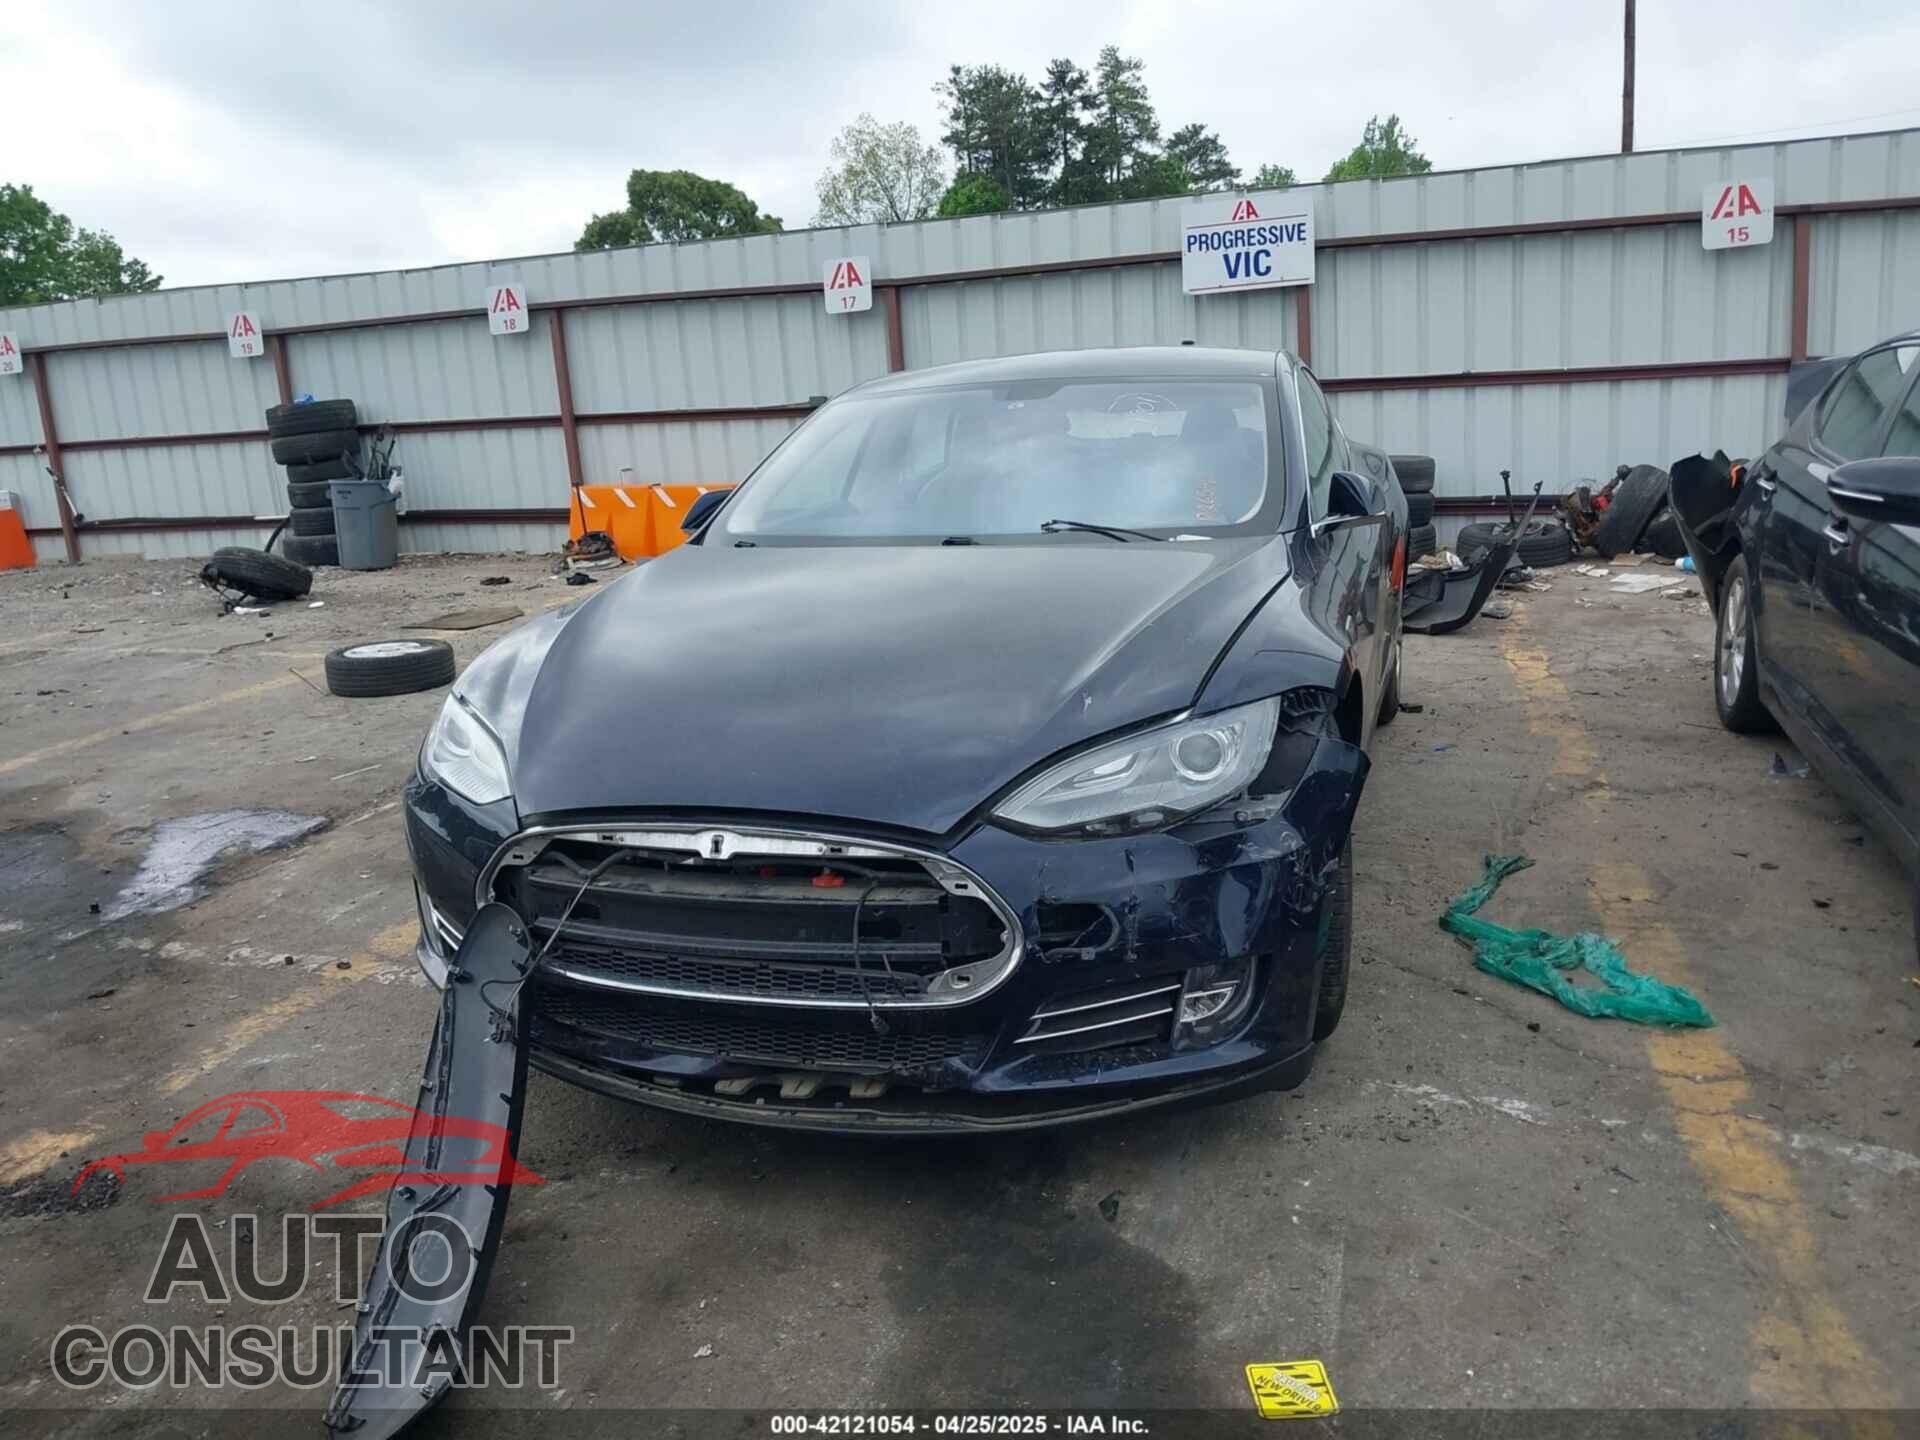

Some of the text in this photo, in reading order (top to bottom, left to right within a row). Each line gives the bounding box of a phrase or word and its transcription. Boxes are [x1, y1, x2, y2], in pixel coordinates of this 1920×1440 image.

[1187, 223, 1307, 253] PROGRESSIVE
[1727, 226, 1750, 243] 15
[1223, 249, 1272, 279] VIC
[841, 295, 857, 310] 17
[503, 318, 517, 331] 18
[241, 342, 254, 355] 19
[1282, 1388, 1322, 1412] DRIVER
